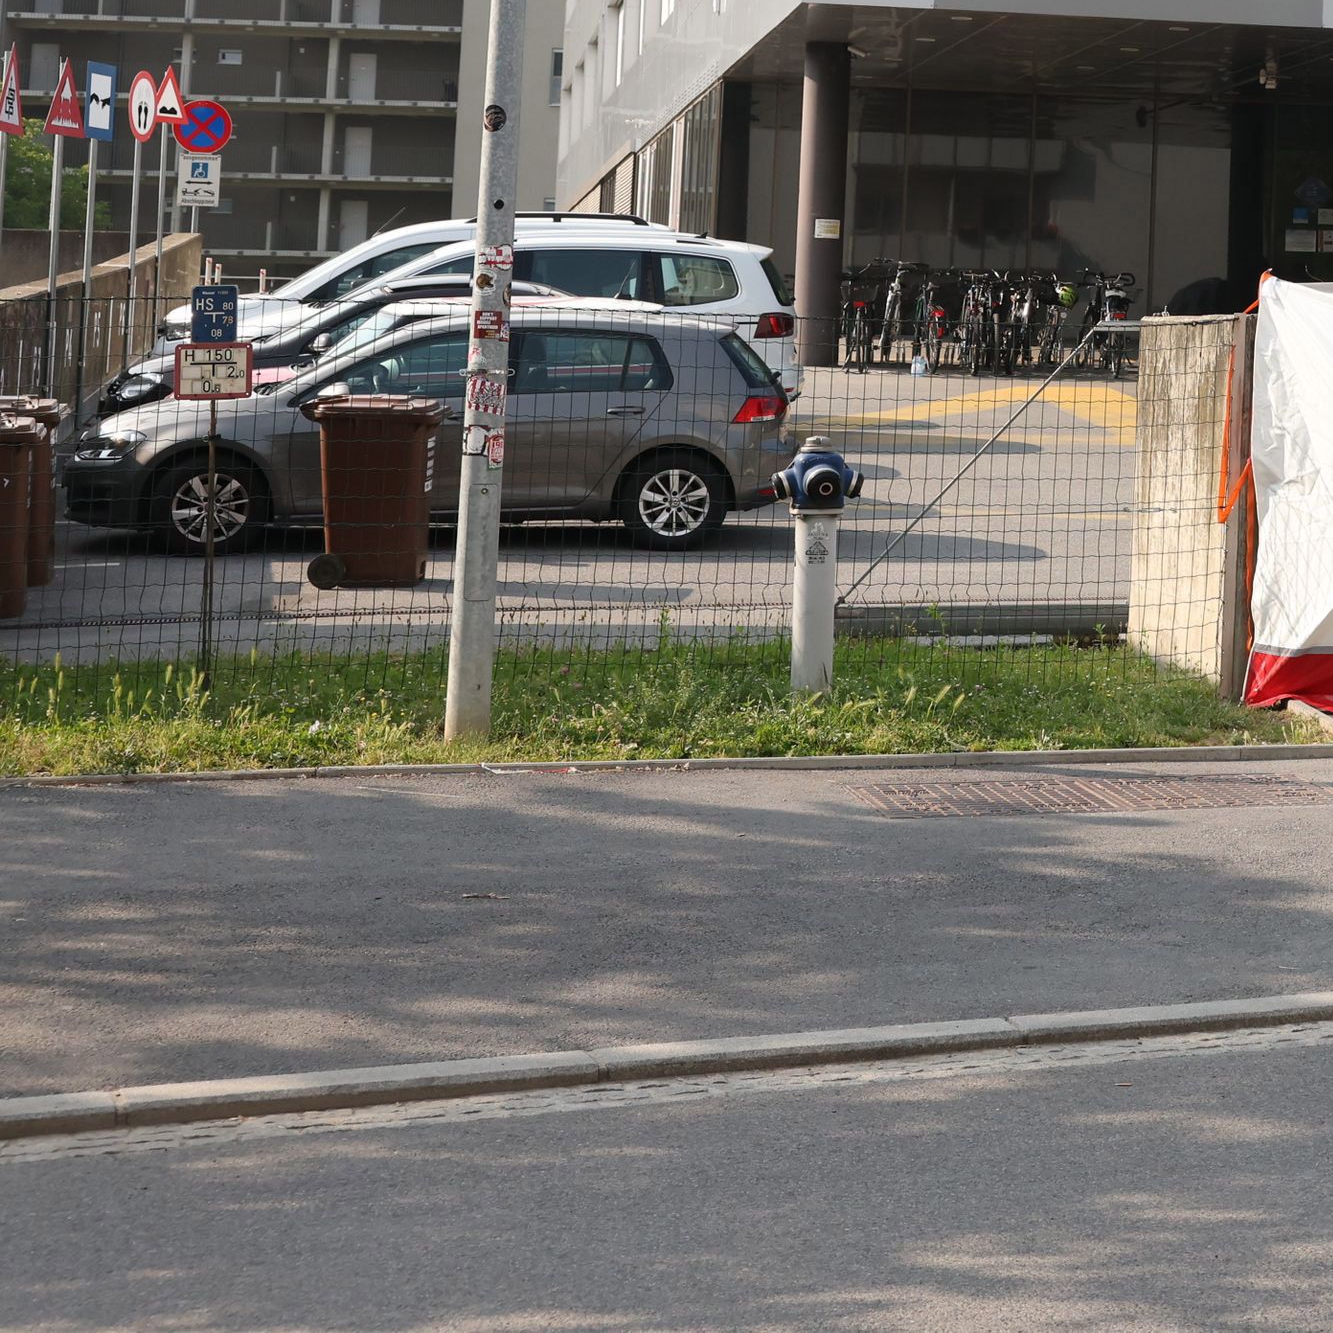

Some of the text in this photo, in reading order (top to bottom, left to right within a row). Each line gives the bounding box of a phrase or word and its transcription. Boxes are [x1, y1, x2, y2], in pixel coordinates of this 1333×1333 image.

[195, 297, 234, 311] HS 80
[184, 348, 233, 362] H 150
